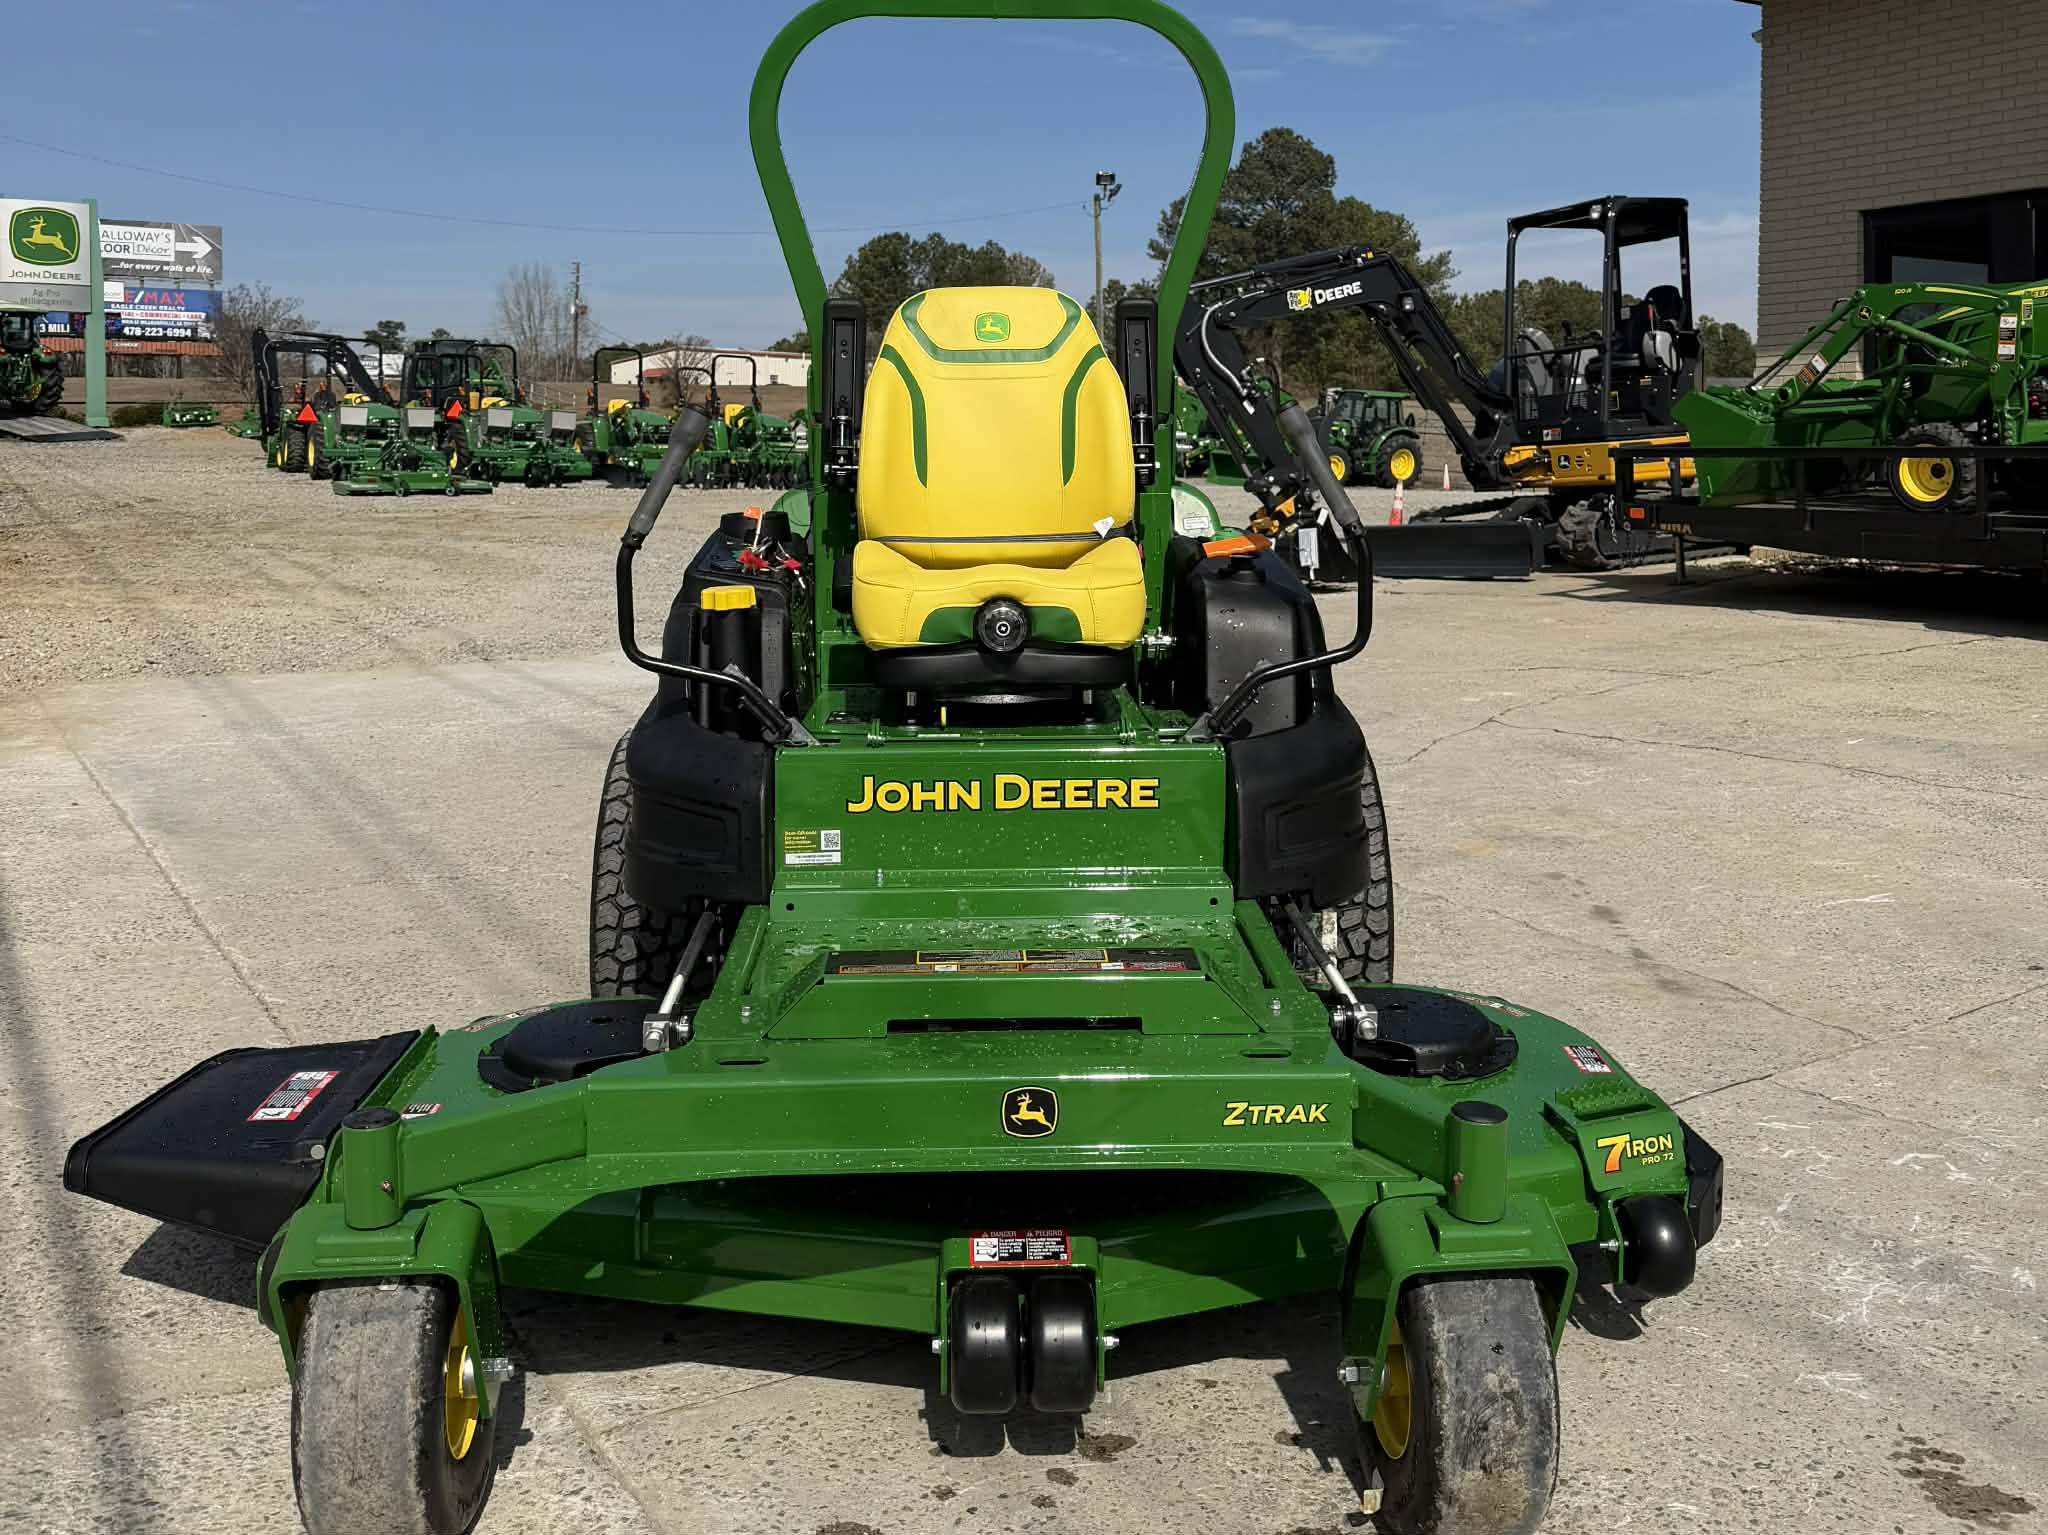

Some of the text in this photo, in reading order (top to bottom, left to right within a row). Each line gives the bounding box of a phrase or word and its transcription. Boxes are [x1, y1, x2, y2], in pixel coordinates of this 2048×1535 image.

[8, 269, 82, 281] JOHN DEERE
[135, 263, 160, 272] every
[163, 264, 182, 272] walk
[1313, 281, 1363, 305] DEERE
[846, 772, 1161, 813] JOHN DEERE
[1222, 1101, 1331, 1126] ZTRAK
[1641, 1152, 1675, 1166] PRO 72
